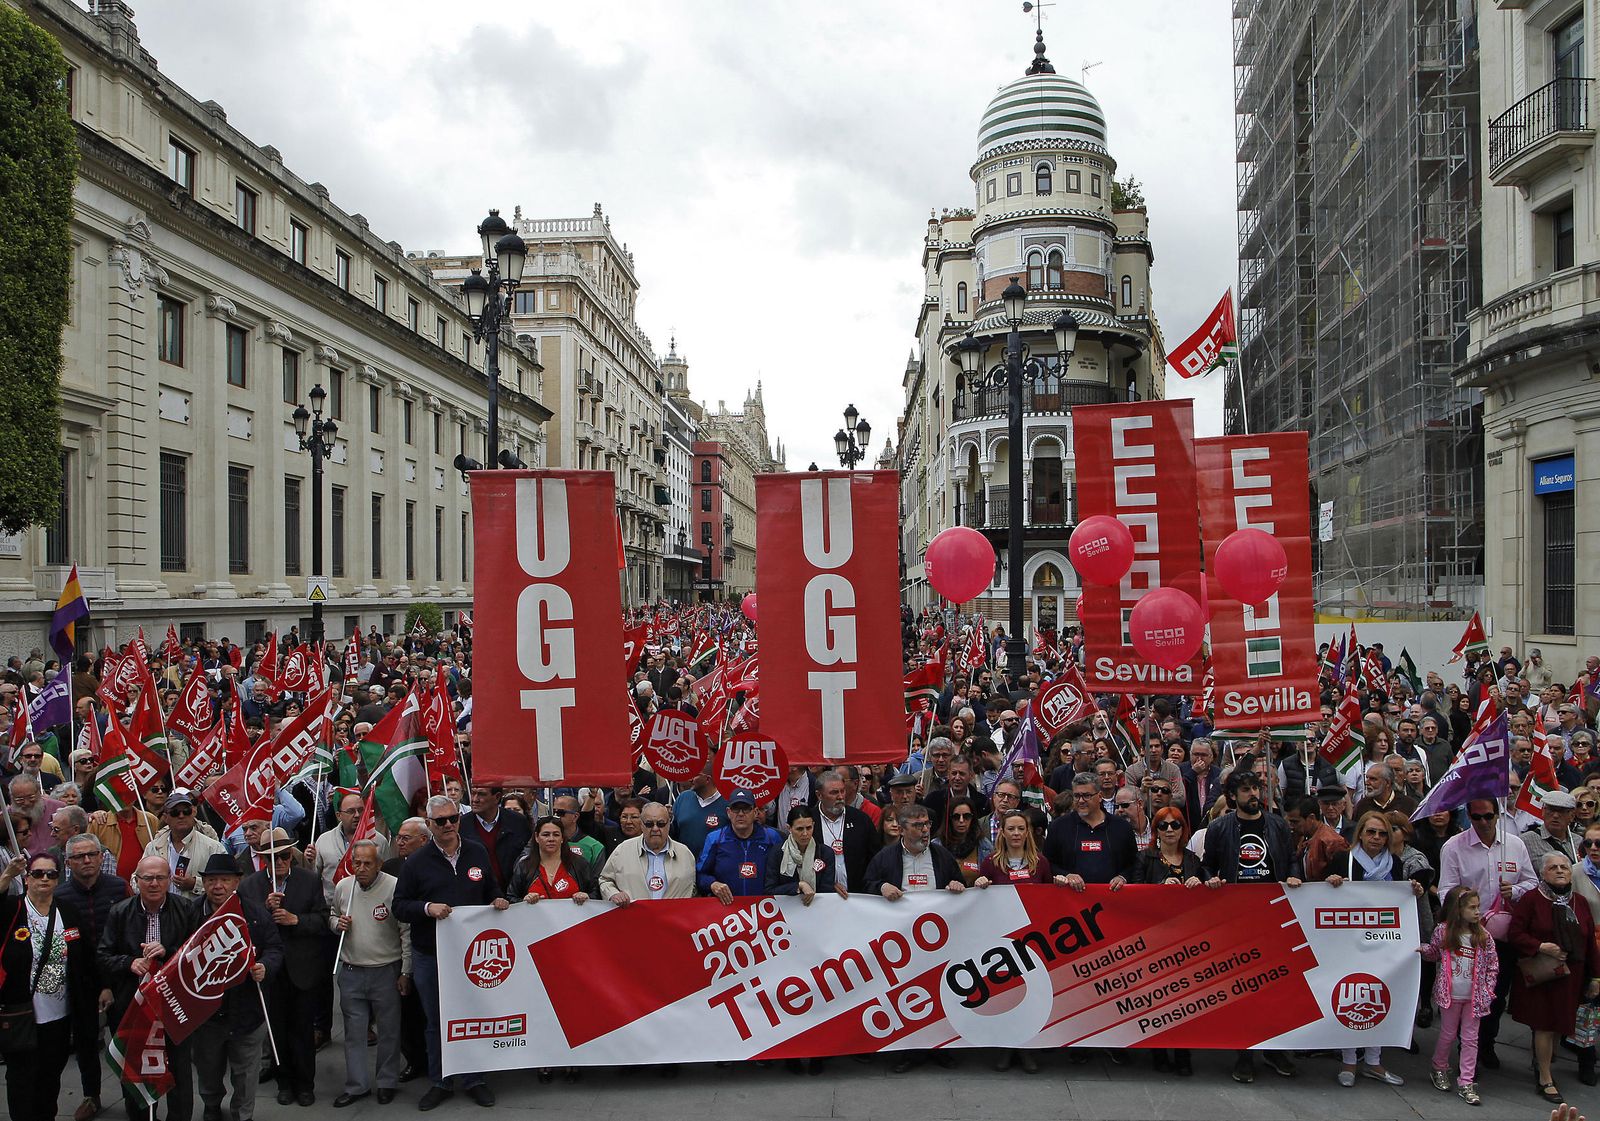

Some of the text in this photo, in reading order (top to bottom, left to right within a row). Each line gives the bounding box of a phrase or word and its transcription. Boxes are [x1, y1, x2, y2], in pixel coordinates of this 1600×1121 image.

[1540, 473, 1573, 486] Allianz Seguros
[1111, 415, 1161, 601] CCOO
[1078, 537, 1108, 555] CCOO
[1087, 545, 1110, 558] Sevilla
[1231, 447, 1280, 632] CCO
[515, 478, 576, 782] UGT
[800, 478, 857, 759] UGT
[1144, 627, 1185, 641] CCOO
[1155, 637, 1185, 648] Sevilla
[1095, 657, 1193, 683] Sevilla
[1223, 686, 1312, 717] Sevilla
[651, 714, 699, 748] UGT
[723, 741, 777, 769] UGT
[691, 897, 780, 952] mayo
[1319, 911, 1379, 926] CCOO
[1365, 931, 1401, 941] Sevilla
[471, 938, 509, 965] UGT
[704, 921, 792, 986] 2018
[1072, 936, 1147, 978] Igualdad
[708, 912, 949, 1041] Tiempo
[862, 903, 1106, 1038] de ganar
[1094, 940, 1211, 997] Mejor empleo
[1115, 947, 1262, 1015] Mayores salarios
[478, 979, 502, 989] Sevilla
[1339, 982, 1384, 1006] UGT
[1138, 964, 1290, 1034] Pensiones dignas
[451, 1019, 508, 1038] CCOO
[1348, 1021, 1375, 1030] Sevilla
[492, 1038, 527, 1049] Sevilla
